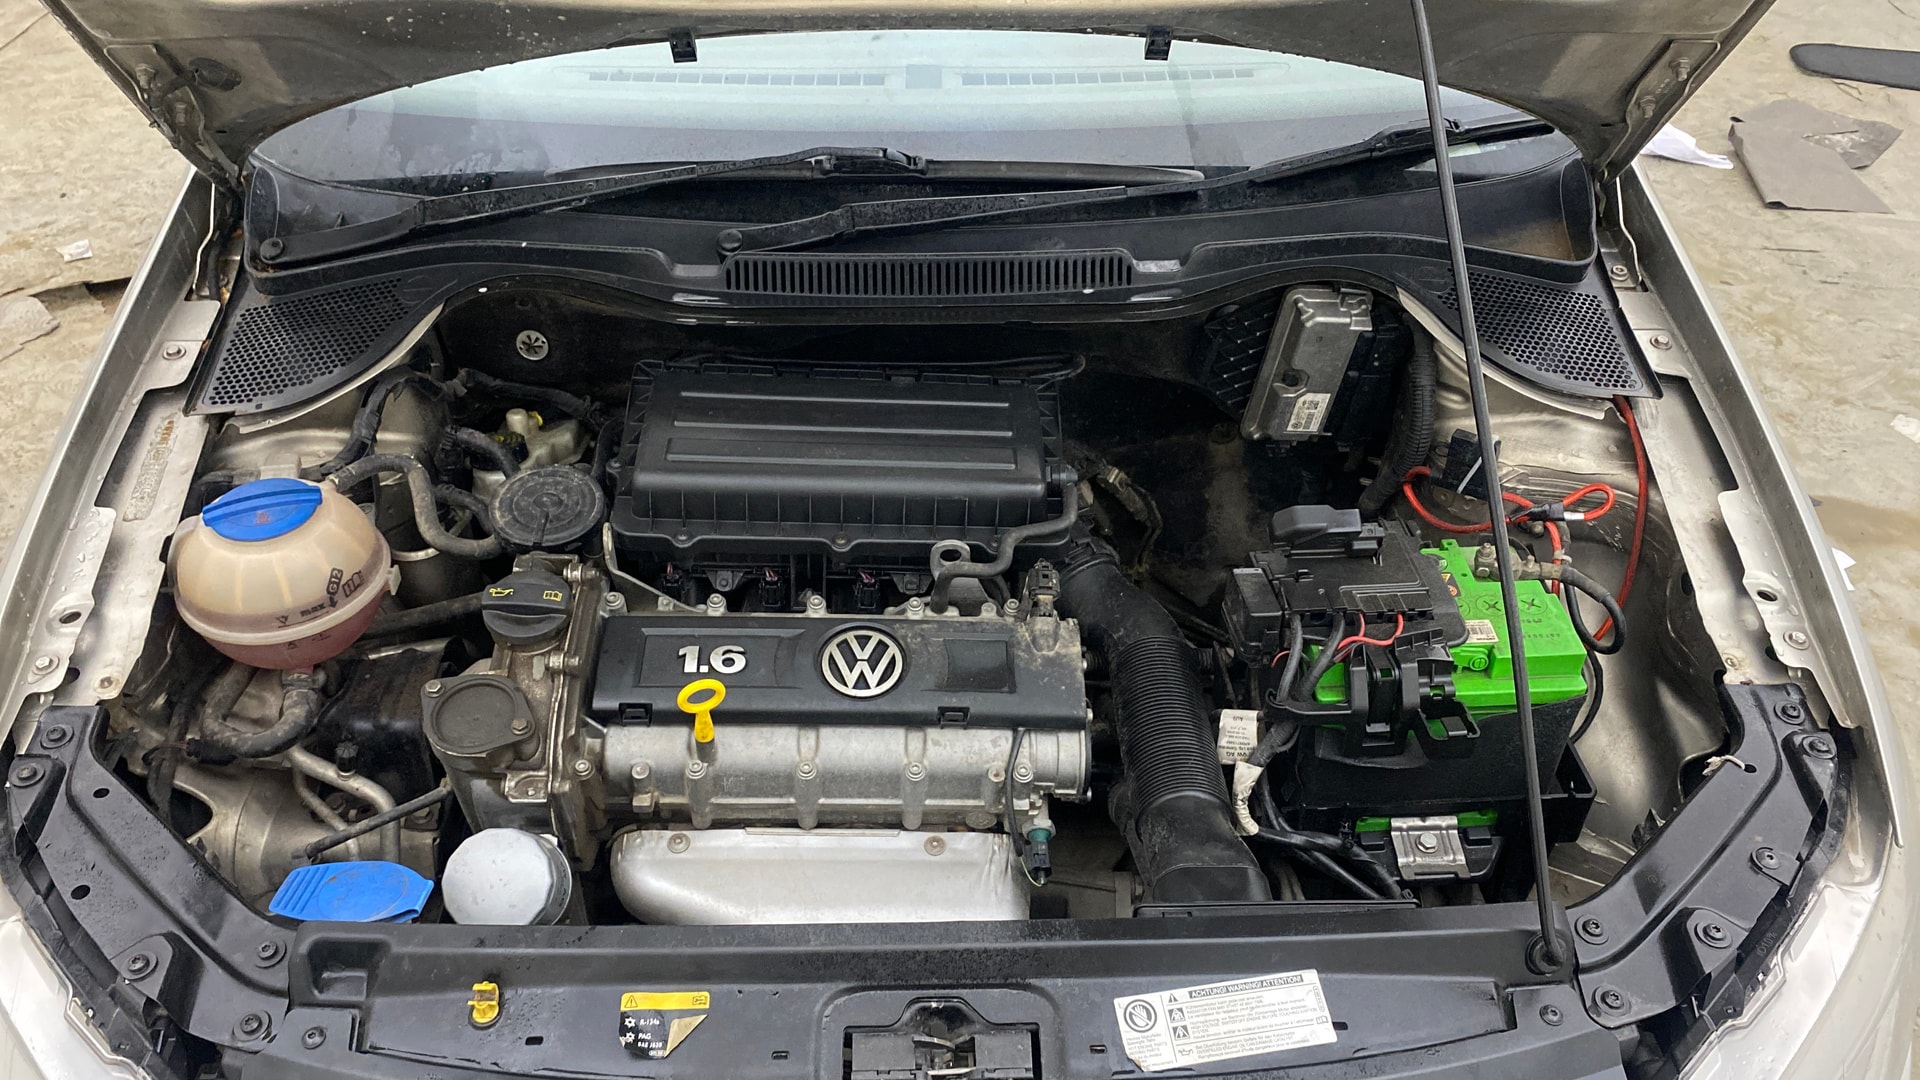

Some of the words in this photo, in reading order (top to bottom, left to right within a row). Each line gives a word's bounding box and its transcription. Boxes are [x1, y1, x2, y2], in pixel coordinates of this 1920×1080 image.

[329, 569, 342, 592] G12
[300, 603, 326, 617] max
[678, 644, 747, 674] 1.6
[821, 630, 903, 697] VW
[1191, 986, 1227, 997] ACHTUNG!
[1228, 981, 1261, 992] WARNING!
[1262, 975, 1301, 987] ATTENTION!
